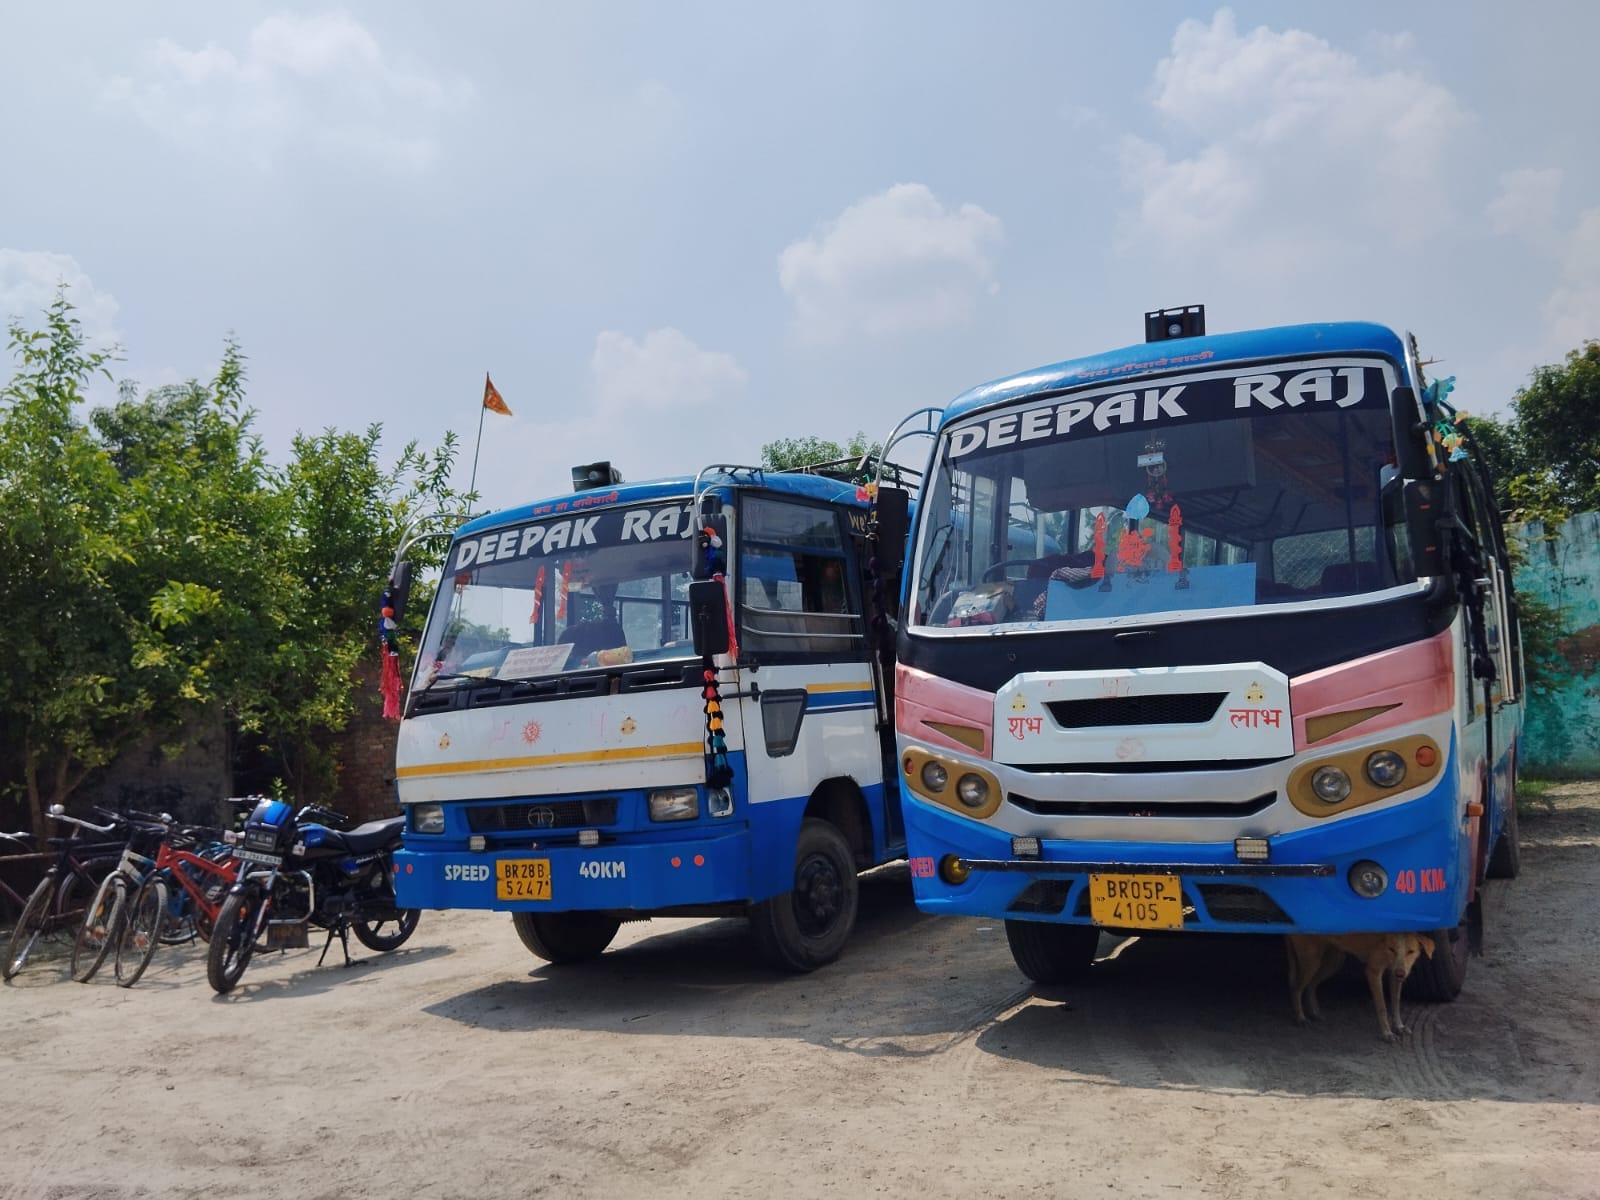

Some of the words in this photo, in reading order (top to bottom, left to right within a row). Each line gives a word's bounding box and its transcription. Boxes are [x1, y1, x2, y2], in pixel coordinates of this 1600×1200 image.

[947, 385, 1188, 459] DEEPAK
[1234, 367, 1365, 410] RAJ
[454, 516, 600, 571] DEEPAK
[621, 502, 698, 542] RAJ
[1008, 717, 1043, 740] शुभ
[1229, 709, 1282, 729] लाभ
[445, 864, 490, 882] SPEED
[579, 861, 626, 878] 40KM
[506, 880, 543, 896] 5247
[1396, 870, 1416, 893] 40
[1113, 902, 1158, 921] 4105
